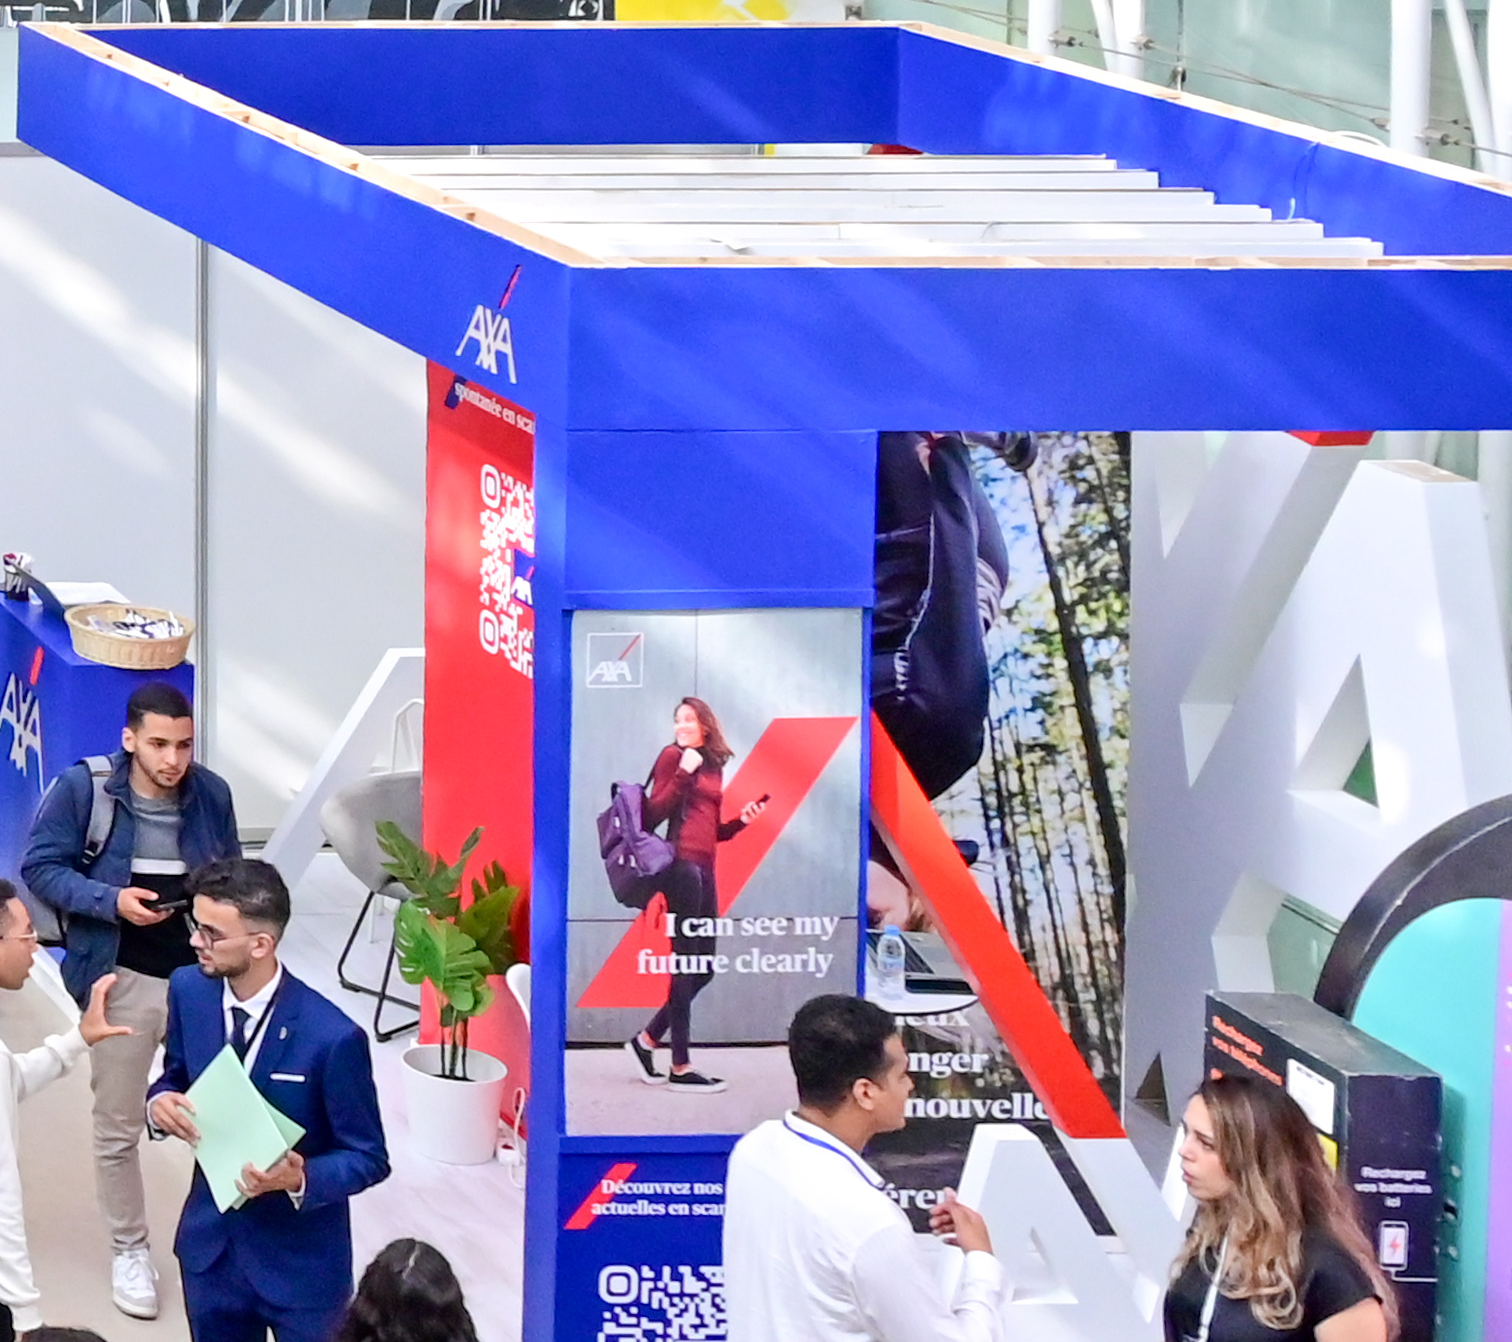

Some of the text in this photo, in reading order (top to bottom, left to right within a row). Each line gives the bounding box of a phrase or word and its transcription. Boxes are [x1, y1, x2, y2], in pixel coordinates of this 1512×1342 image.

[455, 304, 517, 385] AXA
[503, 407, 516, 427] en
[588, 660, 633, 682] AXA
[666, 913, 840, 941] I can see my
[637, 947, 834, 977] future clearly
[908, 1050, 989, 1078] nger
[601, 1179, 723, 1195] Découvrez nos
[592, 1199, 665, 1215] actuelles
[668, 1203, 689, 1215] en
